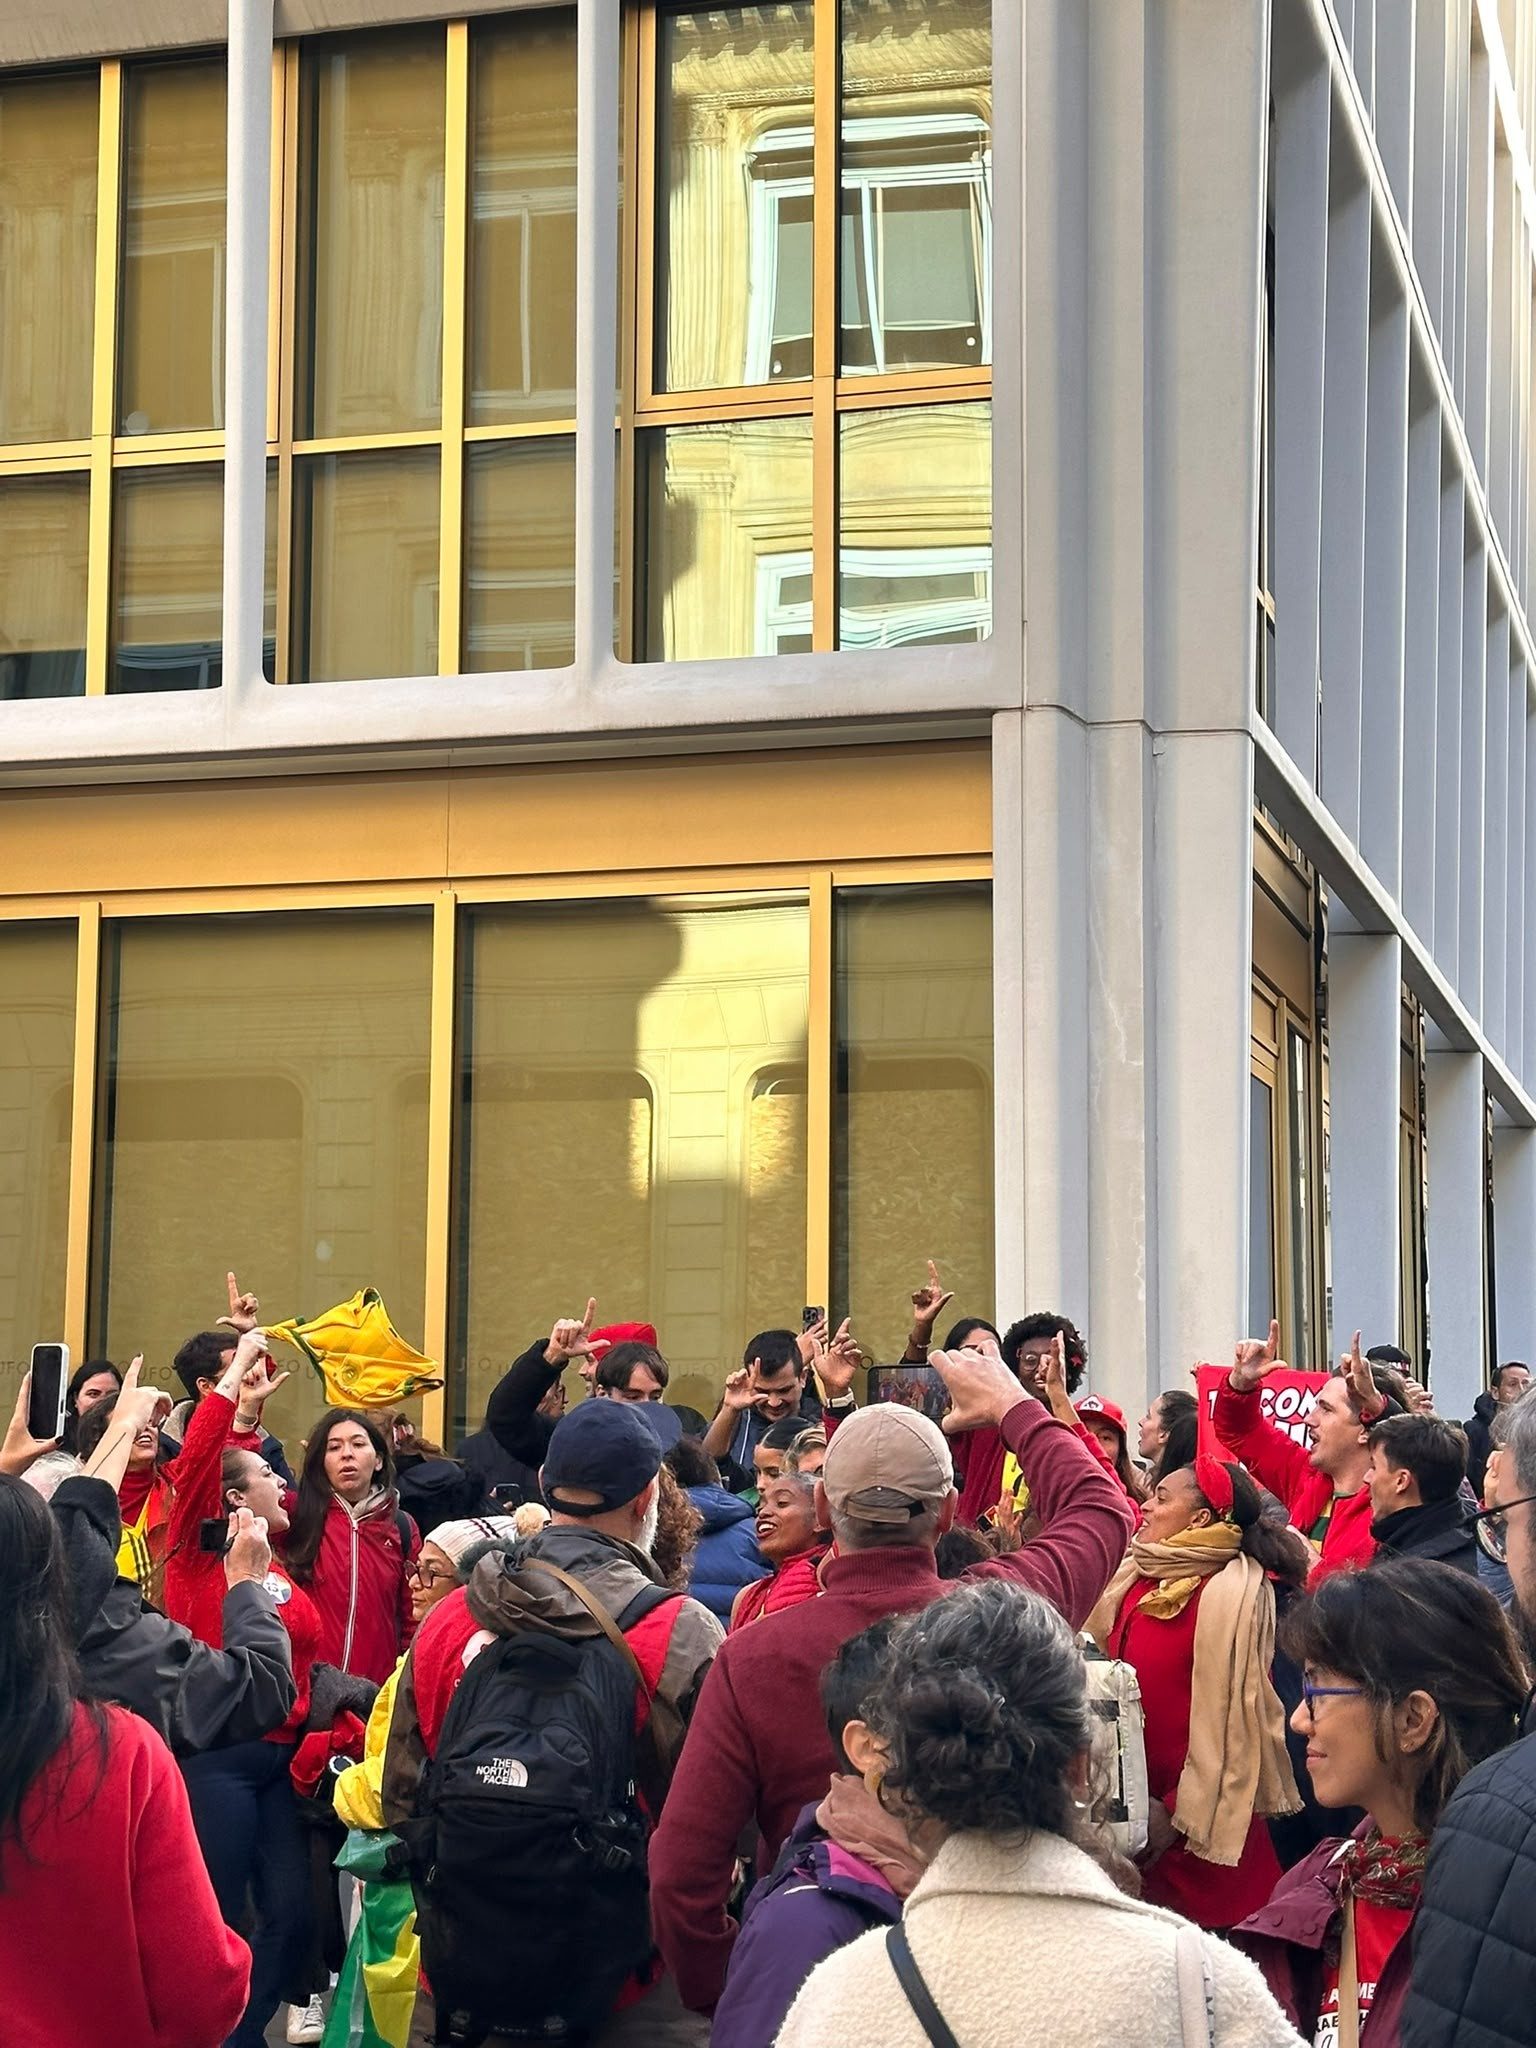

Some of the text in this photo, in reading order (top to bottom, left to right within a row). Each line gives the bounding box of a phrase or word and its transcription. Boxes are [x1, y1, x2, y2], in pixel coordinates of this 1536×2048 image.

[493, 1757, 512, 1768] THE
[476, 1765, 510, 1777] NORTH
[483, 1775, 509, 1786] FACE
